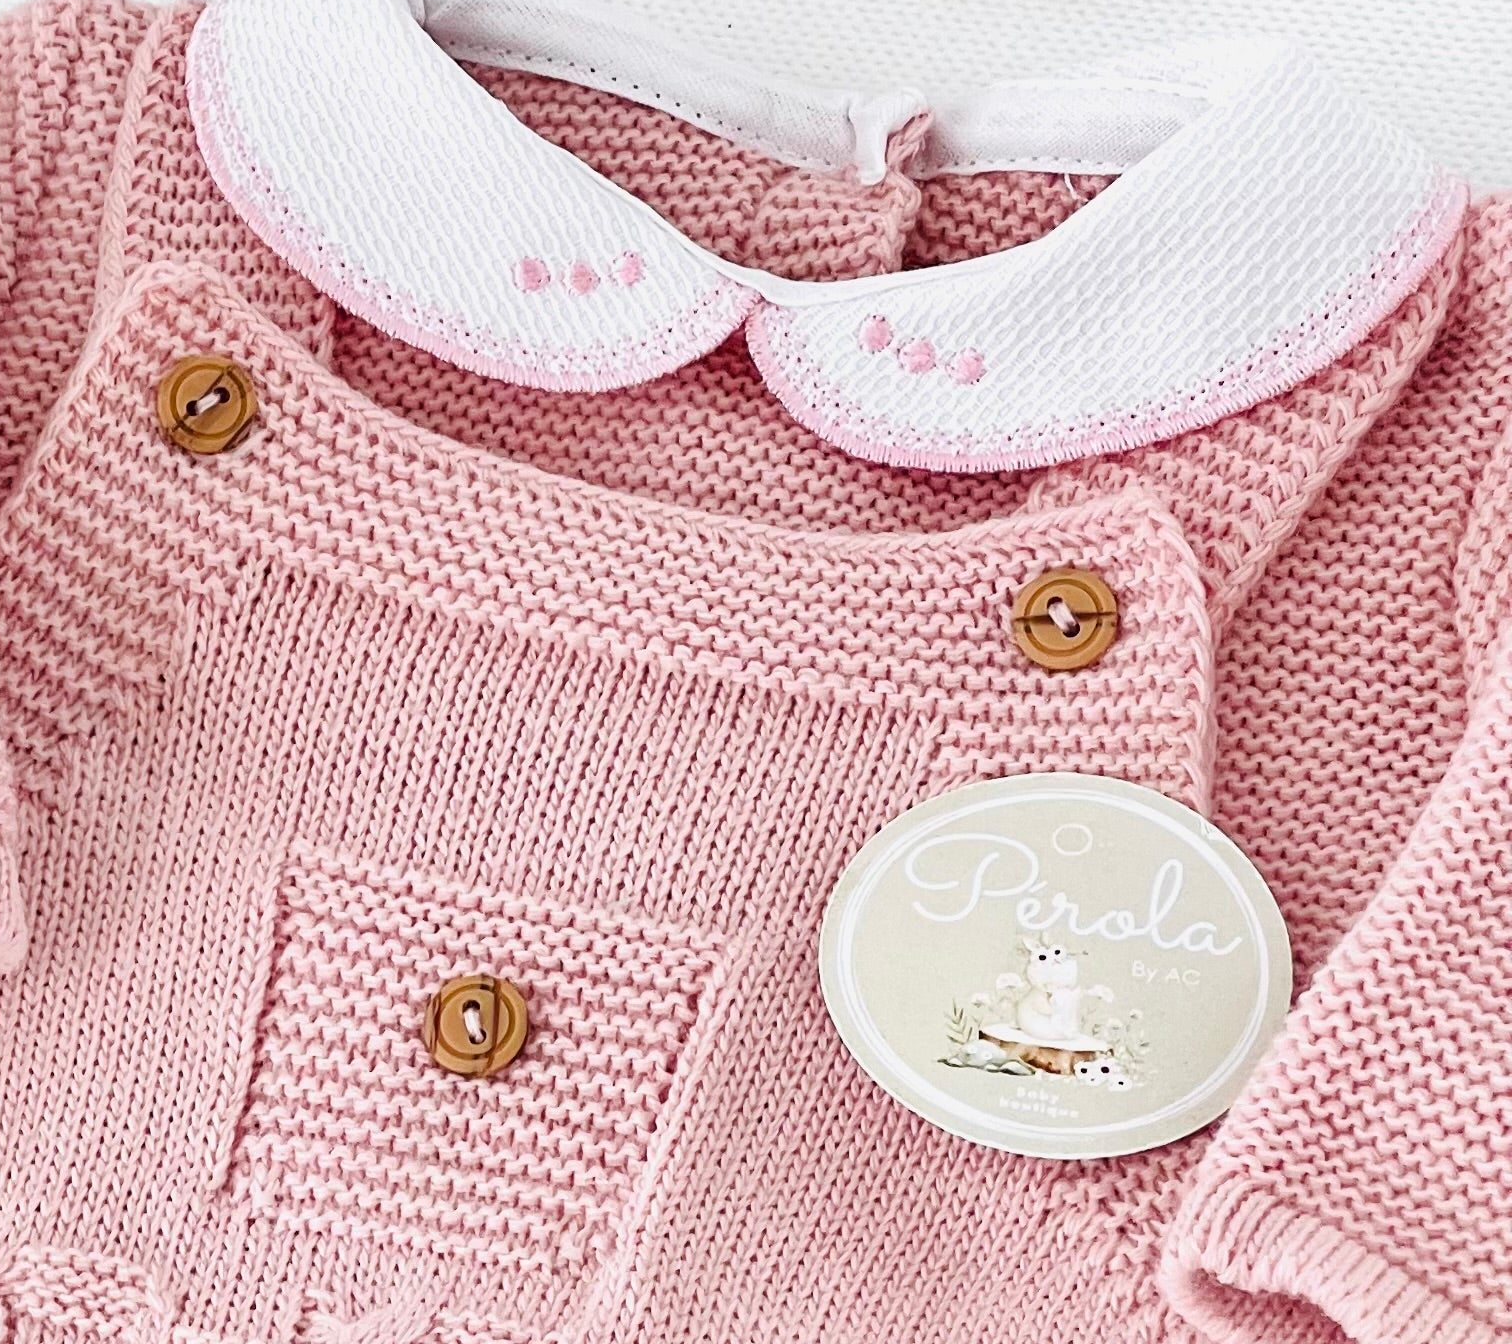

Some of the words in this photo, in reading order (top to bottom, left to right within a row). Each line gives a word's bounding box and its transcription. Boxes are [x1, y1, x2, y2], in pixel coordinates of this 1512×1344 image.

[905, 833, 1242, 955] Pérola
[1131, 960, 1157, 985] By
[1164, 968, 1202, 987] AC
